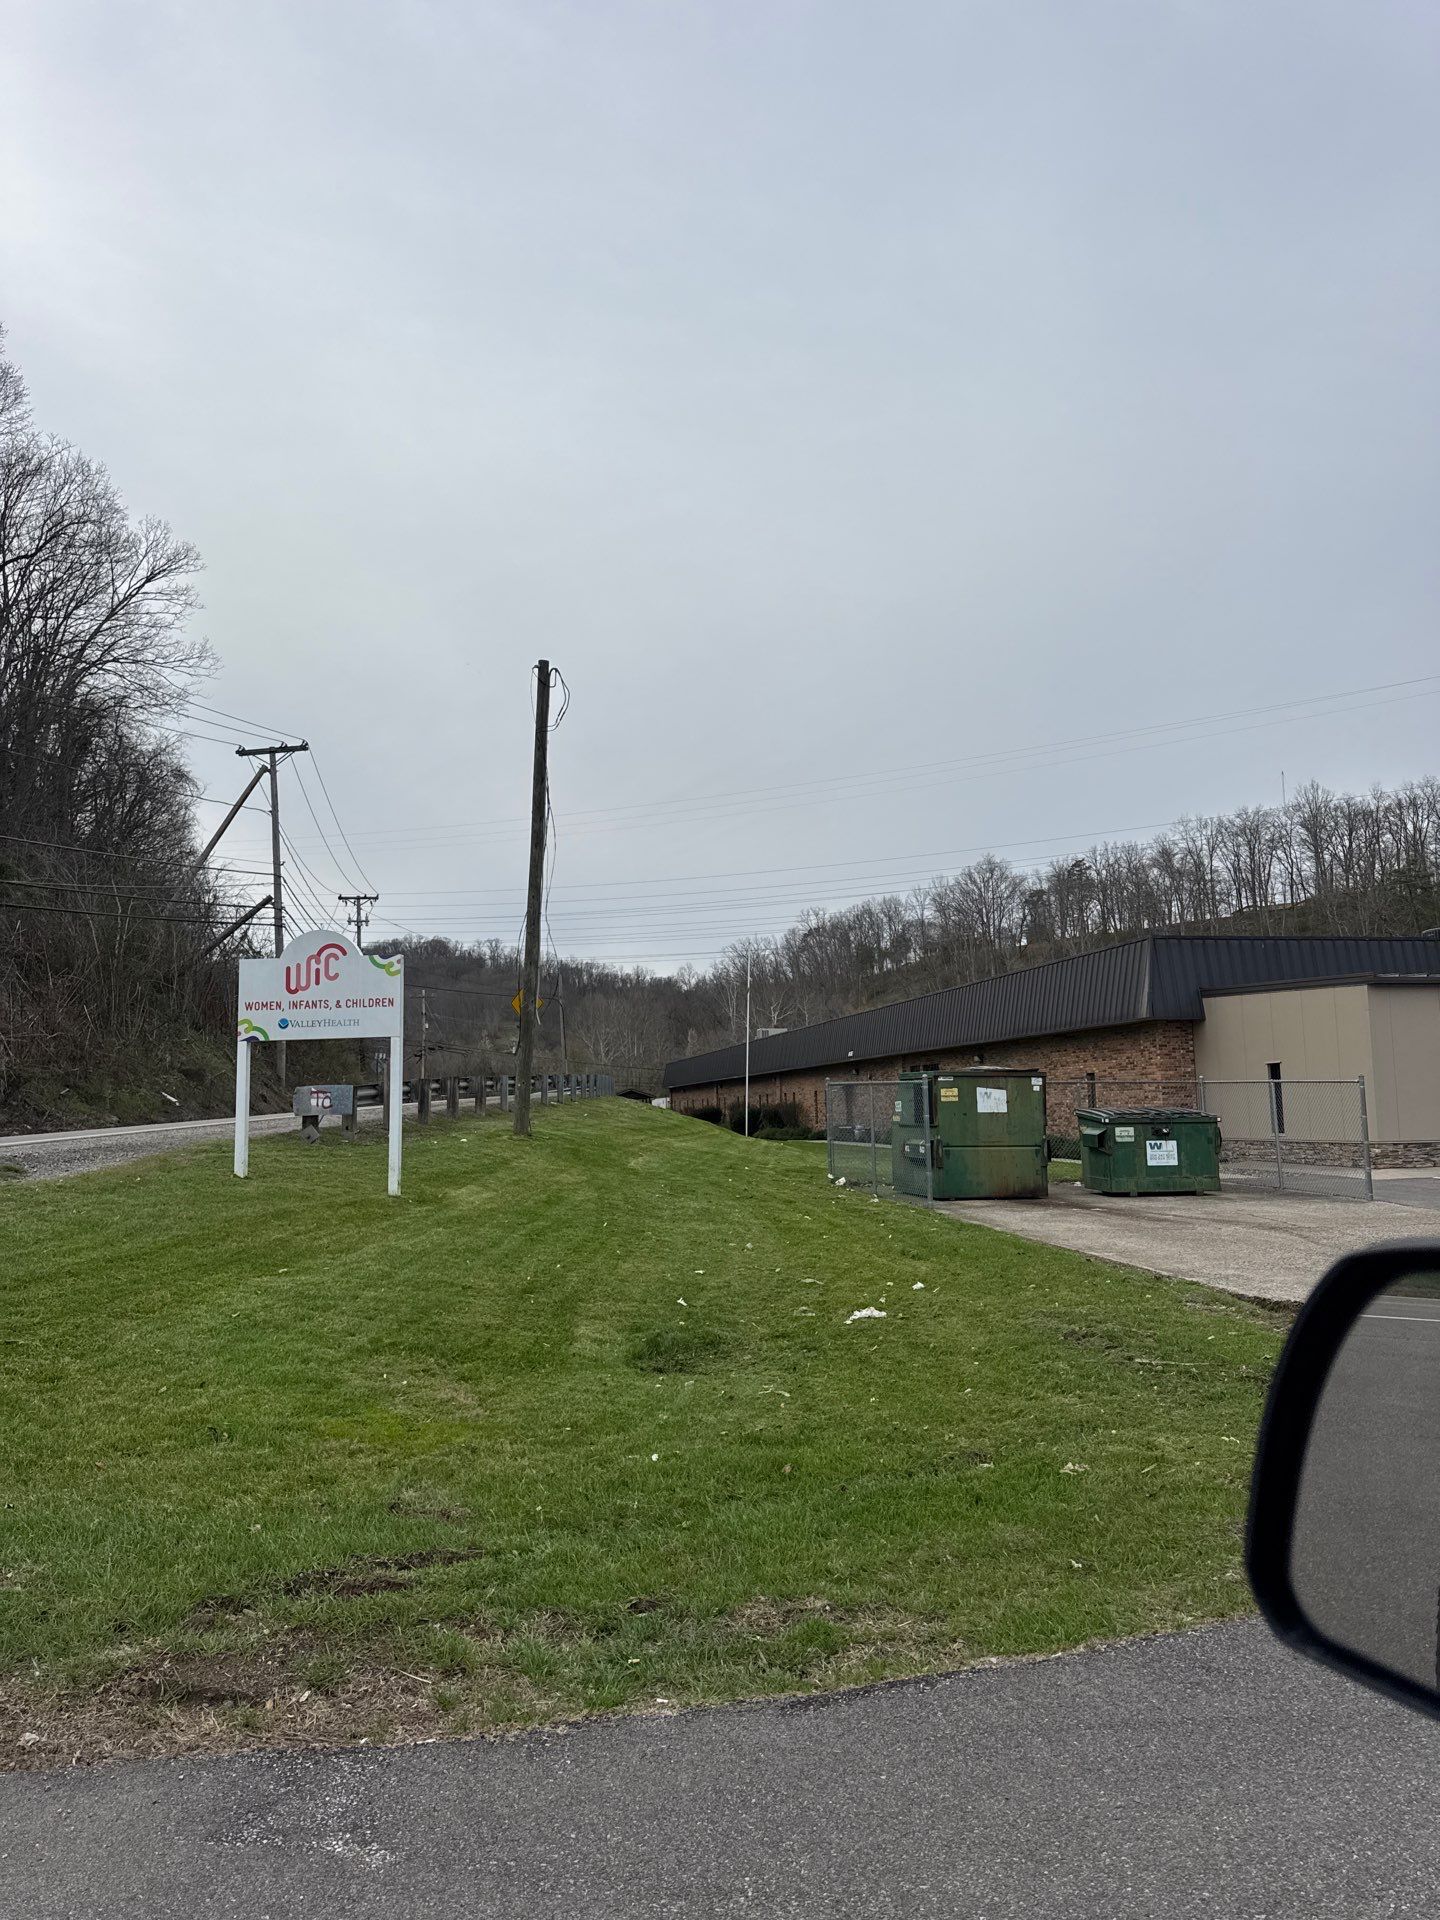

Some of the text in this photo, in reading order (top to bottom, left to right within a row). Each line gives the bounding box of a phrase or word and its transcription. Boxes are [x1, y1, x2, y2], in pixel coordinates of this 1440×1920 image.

[244, 997, 395, 1012] WOMEN, INFANTS, & CHILDREN
